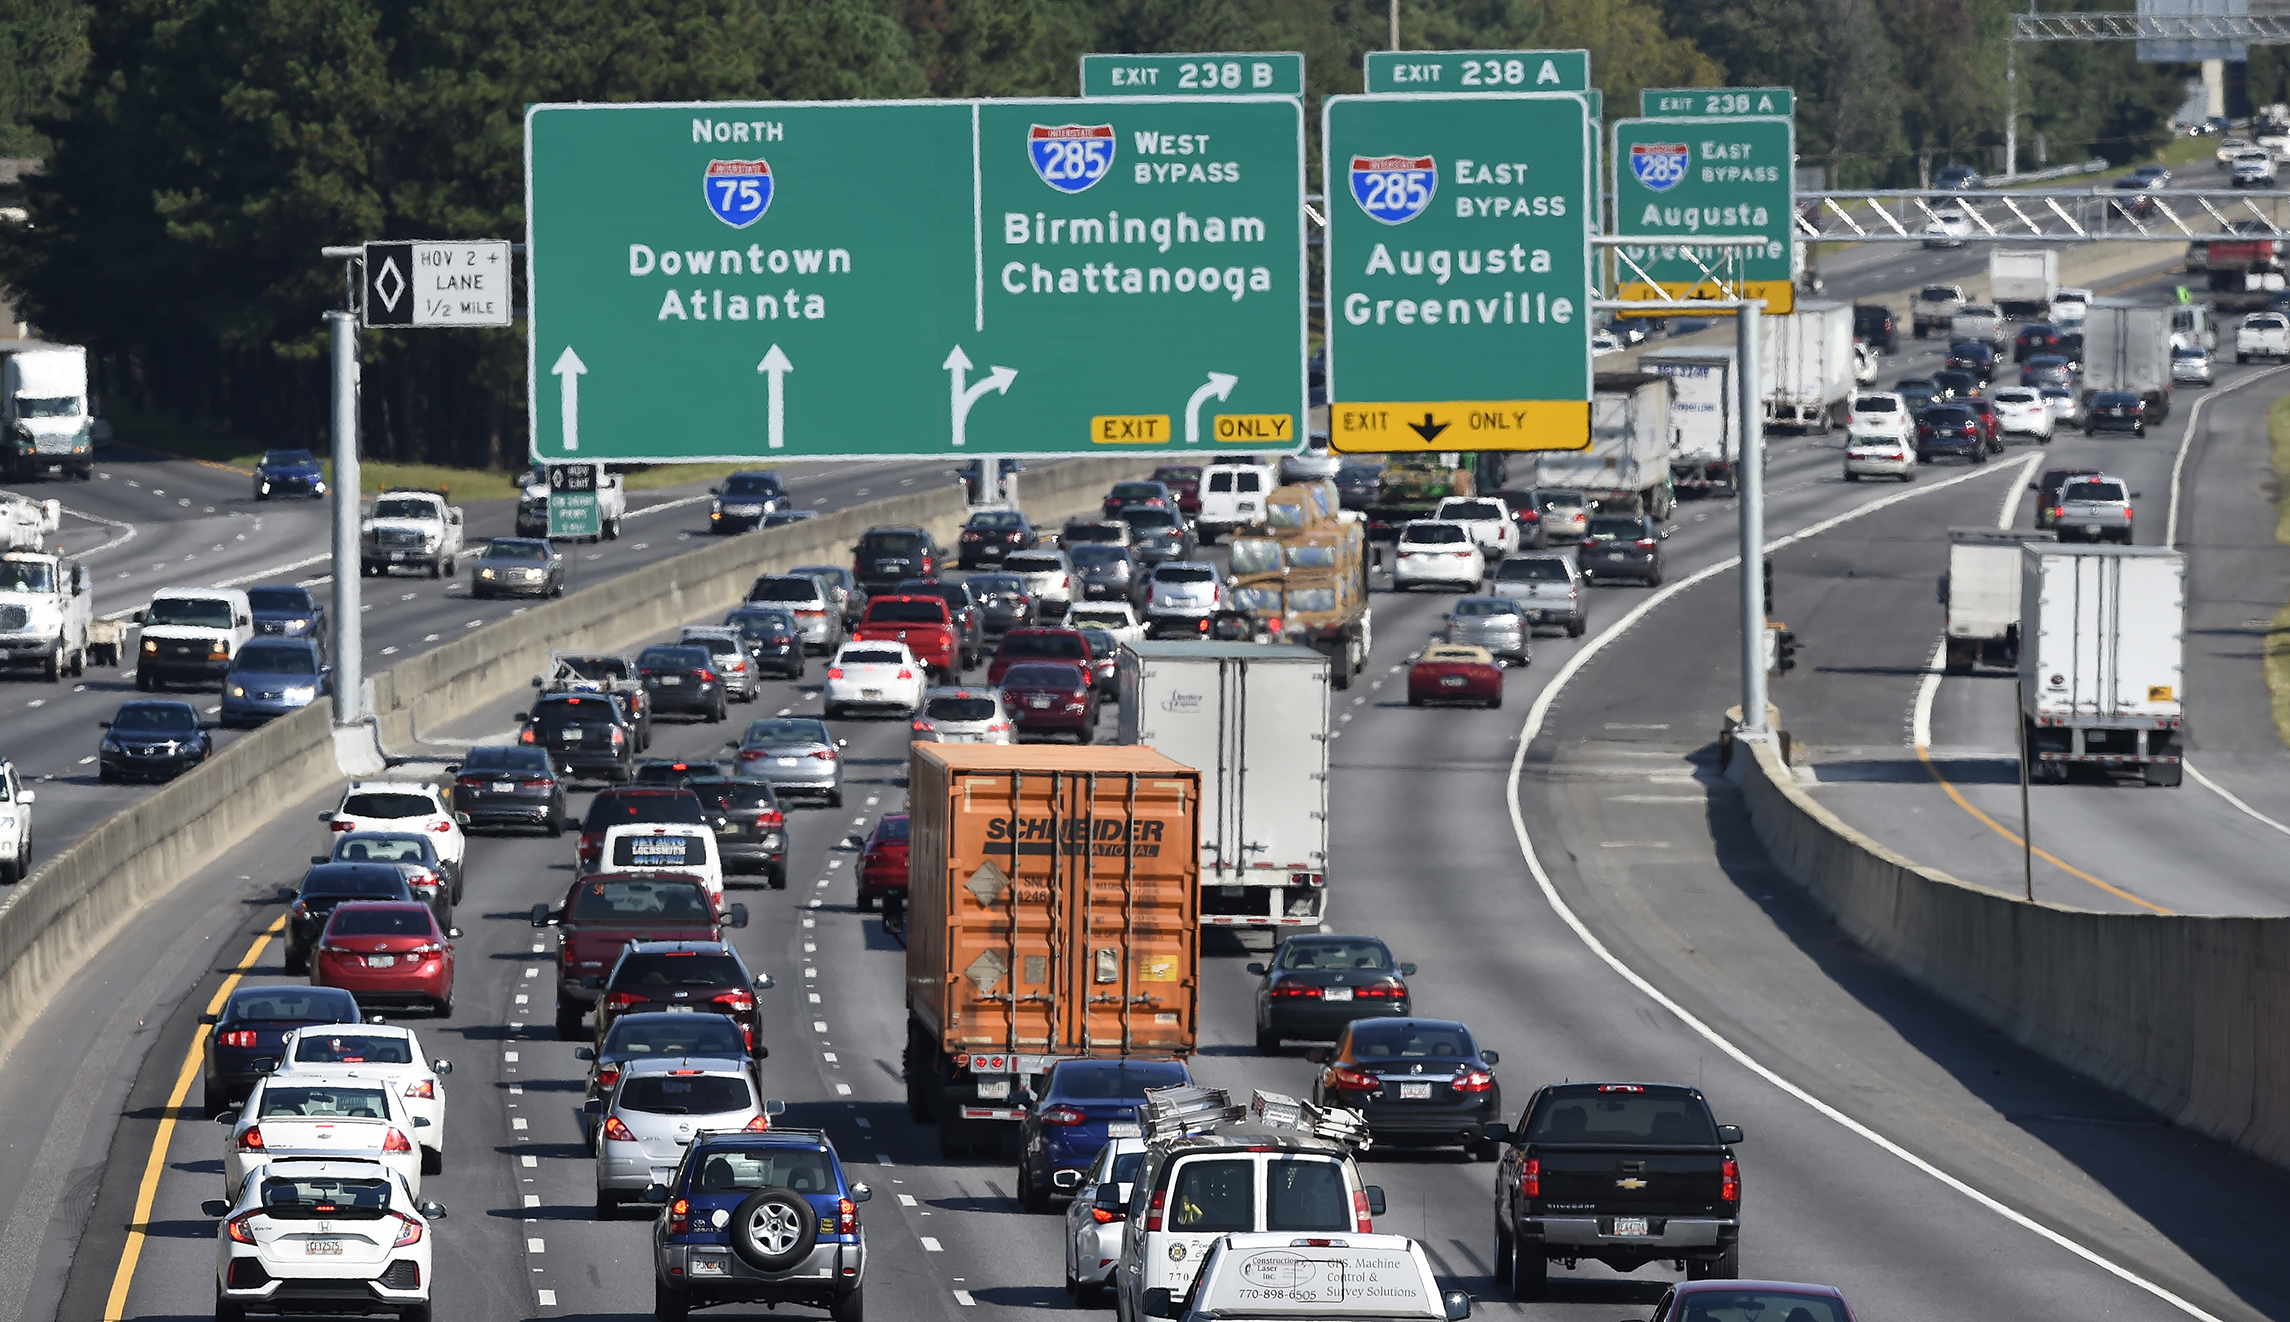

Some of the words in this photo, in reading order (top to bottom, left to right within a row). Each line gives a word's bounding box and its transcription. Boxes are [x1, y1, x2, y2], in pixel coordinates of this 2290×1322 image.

[1112, 67, 1159, 86] EXIT
[1178, 62, 1241, 89] 238
[1252, 62, 1273, 88] B
[1392, 64, 1442, 83] EXIT
[1460, 60, 1525, 85] 238
[1536, 60, 1561, 84] A
[1659, 98, 1694, 111] EXIT
[1758, 94, 1775, 113] A
[692, 118, 784, 143] NORTH
[1134, 131, 1210, 155] WEST
[1701, 141, 1752, 160] EAST
[1043, 142, 1106, 180] 285
[1455, 159, 1528, 185] EAST
[1640, 155, 1684, 181] 285
[1134, 162, 1241, 184] BYPASS
[1701, 166, 1780, 182] BYPASS
[715, 179, 762, 211] 75
[1364, 173, 1428, 209] 285
[1456, 196, 1567, 218] BYPASS
[1640, 203, 1769, 233] Augusta
[1004, 210, 1266, 253] Birmingham
[421, 250, 453, 266] HOV
[467, 251, 476, 266] 2
[629, 243, 851, 277] Downtown
[1364, 243, 1552, 286] Augusta
[436, 274, 483, 290] LANE
[1001, 261, 1271, 302] Chattanooga
[426, 299, 451, 316] 1/2
[460, 302, 493, 314] MILE
[658, 288, 825, 321] Atlanta
[1344, 291, 1573, 325] Greenville
[1103, 420, 1158, 439] EXIT
[1219, 418, 1287, 438] ONLY
[1343, 412, 1389, 431] EXIT
[1469, 410, 1527, 430] ONLY
[986, 818, 1164, 842] SCHNEIDER
[632, 845, 686, 855] LOCKSMITH
[1355, 1258, 1400, 1269] Machine
[1327, 1272, 1365, 1282] Control
[1369, 1272, 1378, 1282] &
[1239, 1289, 1317, 1301] 770-898-6505
[1326, 1286, 1364, 1298] Suvey
[1367, 1286, 1417, 1297] Solutions
